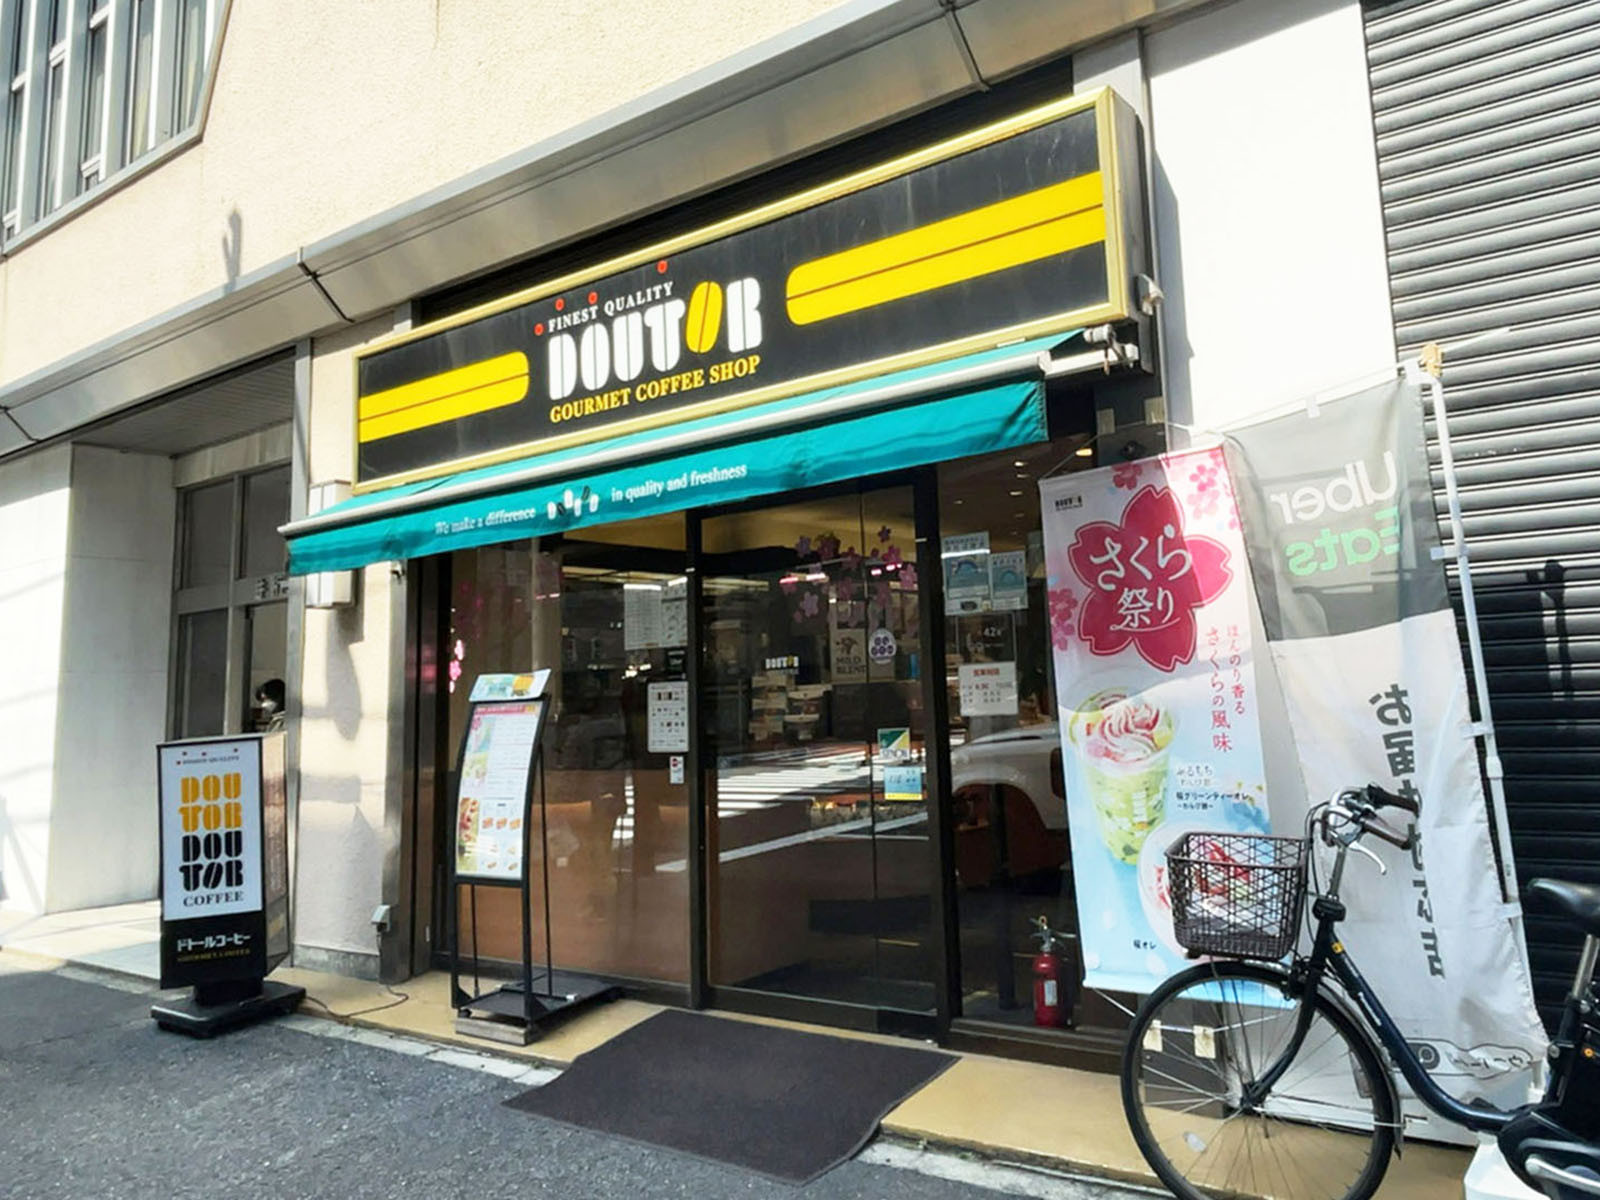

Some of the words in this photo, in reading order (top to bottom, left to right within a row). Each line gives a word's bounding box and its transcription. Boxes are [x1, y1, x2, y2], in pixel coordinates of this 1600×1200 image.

[549, 305, 599, 333] FINEST
[604, 281, 673, 316] QUALITY
[549, 277, 762, 400] DOUTOR
[550, 388, 631, 423] GOURMET
[635, 369, 705, 402] COFFEE
[709, 354, 761, 382] SHOP
[435, 521, 449, 534] We
[451, 517, 475, 533] make
[485, 508, 536, 526] difference
[611, 488, 623, 502] in
[625, 480, 664, 503] quality
[667, 473, 688, 491] and
[690, 464, 748, 486] freshness
[1090, 524, 1193, 590] さくら
[1118, 587, 1175, 627] 祭り
[1206, 627, 1232, 752] さくらの風味
[1227, 624, 1245, 714] ほんのり香る
[181, 772, 242, 804] DOU
[179, 802, 242, 832] TOR
[182, 830, 243, 862] DOU
[179, 860, 243, 891] TOR
[183, 892, 244, 908] COFFEE
[177, 933, 251, 952] ドトールコーヒー
